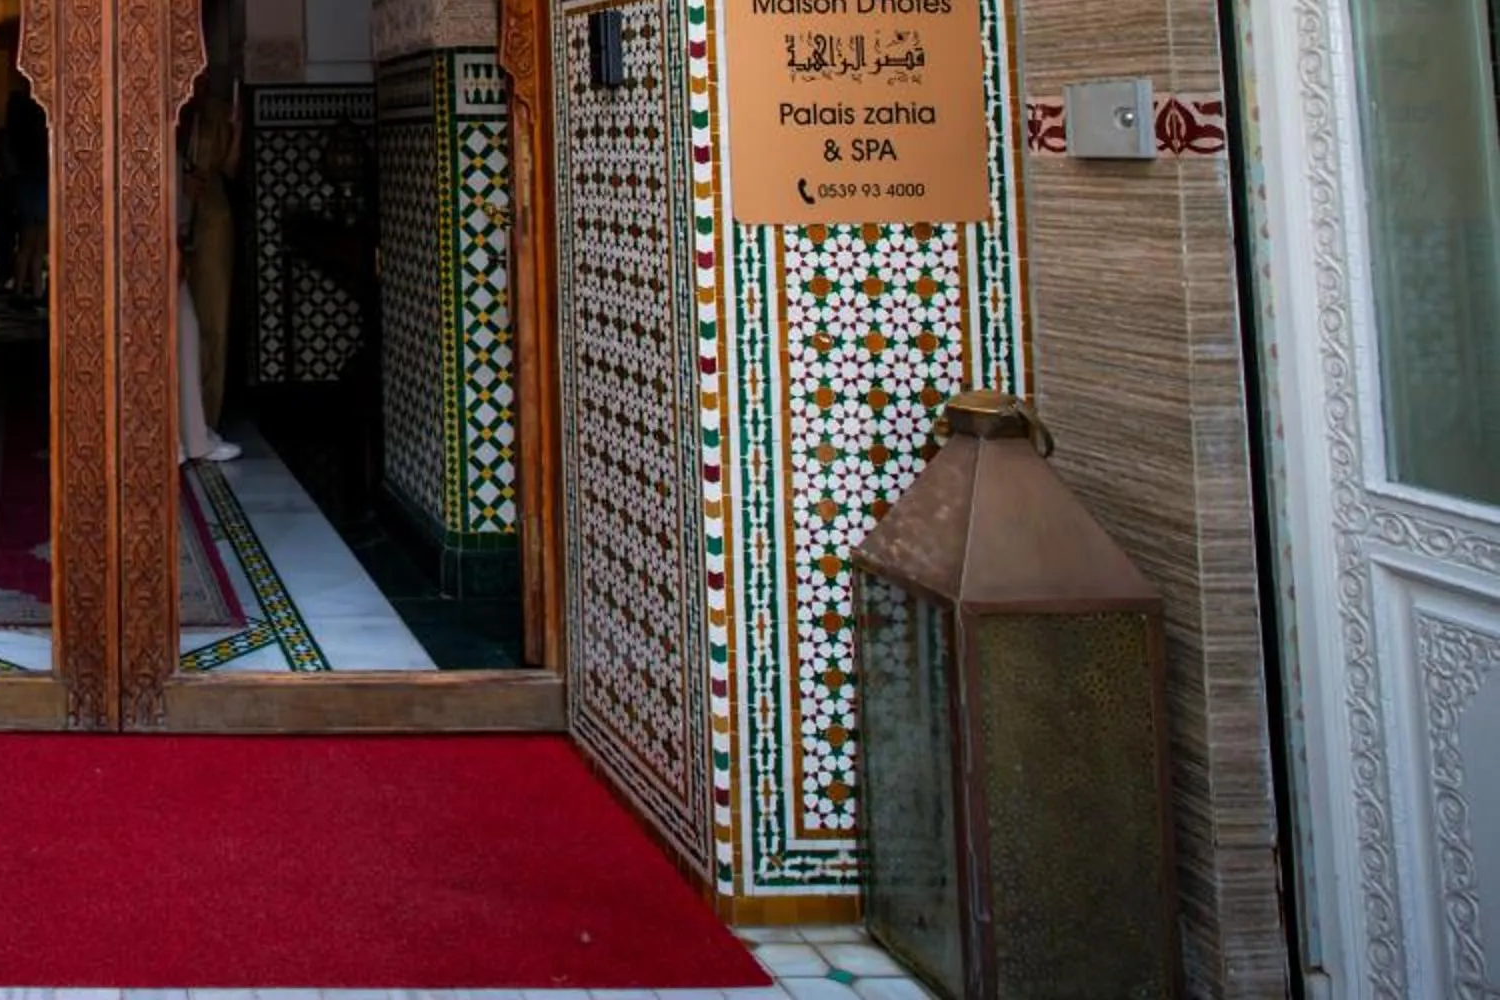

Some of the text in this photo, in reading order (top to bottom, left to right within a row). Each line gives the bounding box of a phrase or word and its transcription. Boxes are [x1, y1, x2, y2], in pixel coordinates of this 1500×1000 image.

[779, 103, 937, 126] Palais zahia
[824, 140, 898, 162] & SPA
[818, 182, 925, 199] 0539 93 4000
